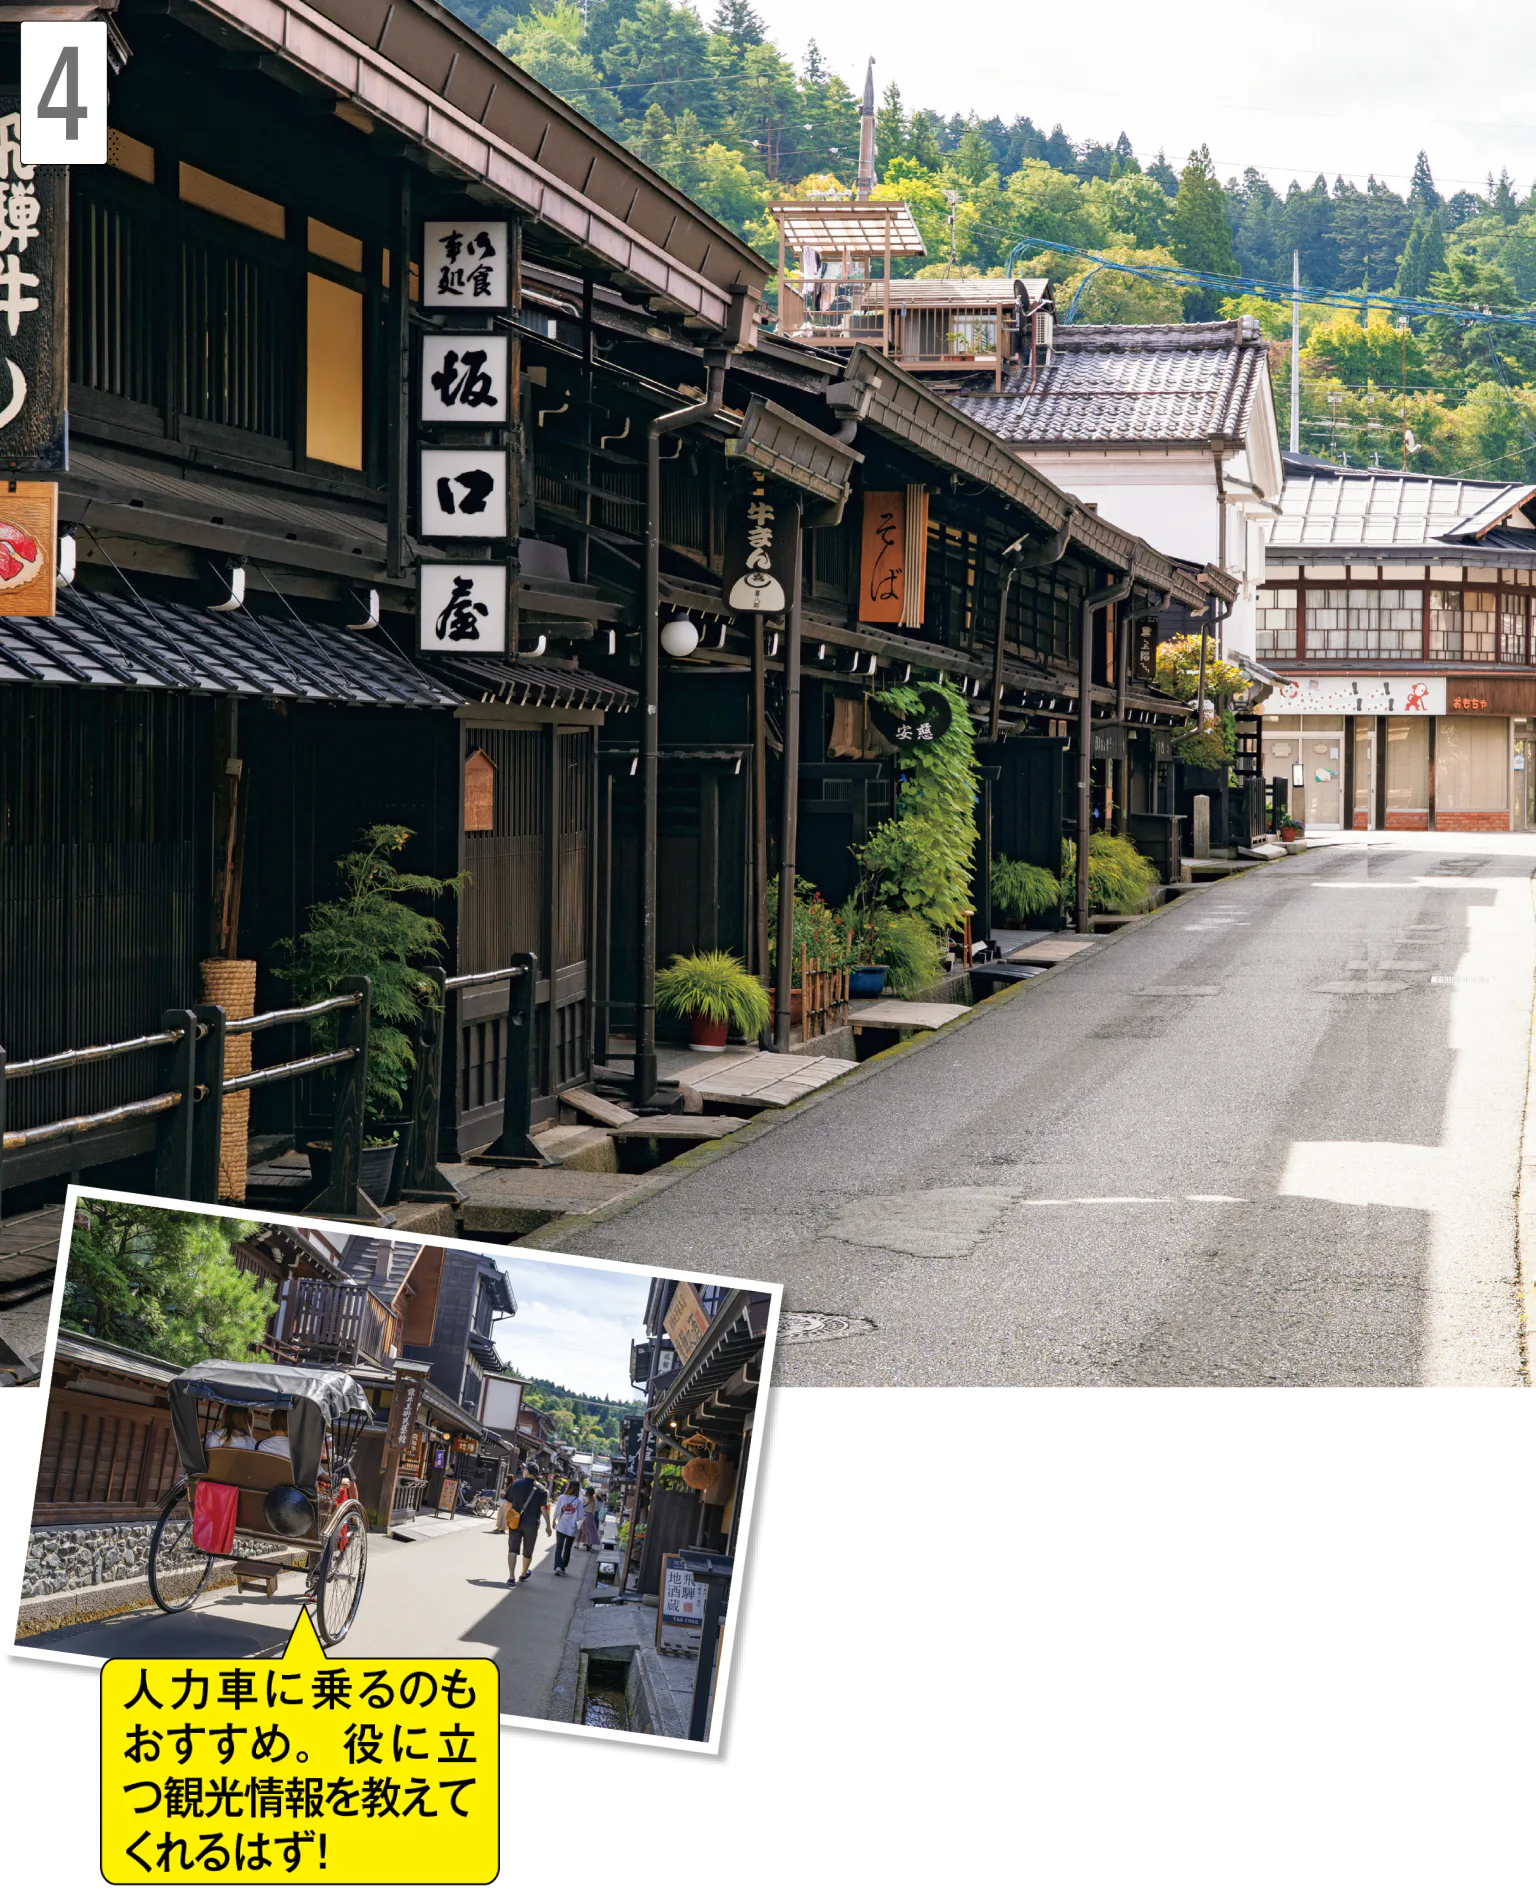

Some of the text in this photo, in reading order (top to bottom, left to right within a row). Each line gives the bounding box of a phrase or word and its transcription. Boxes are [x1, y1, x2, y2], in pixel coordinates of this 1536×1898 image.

[746, 502, 775, 569] 牛まん
[871, 513, 903, 601] そば
[1453, 697, 1487, 710] おもちゃ
[665, 1571, 682, 1613] 地酒蔵
[681, 1573, 696, 1600] 飛騨
